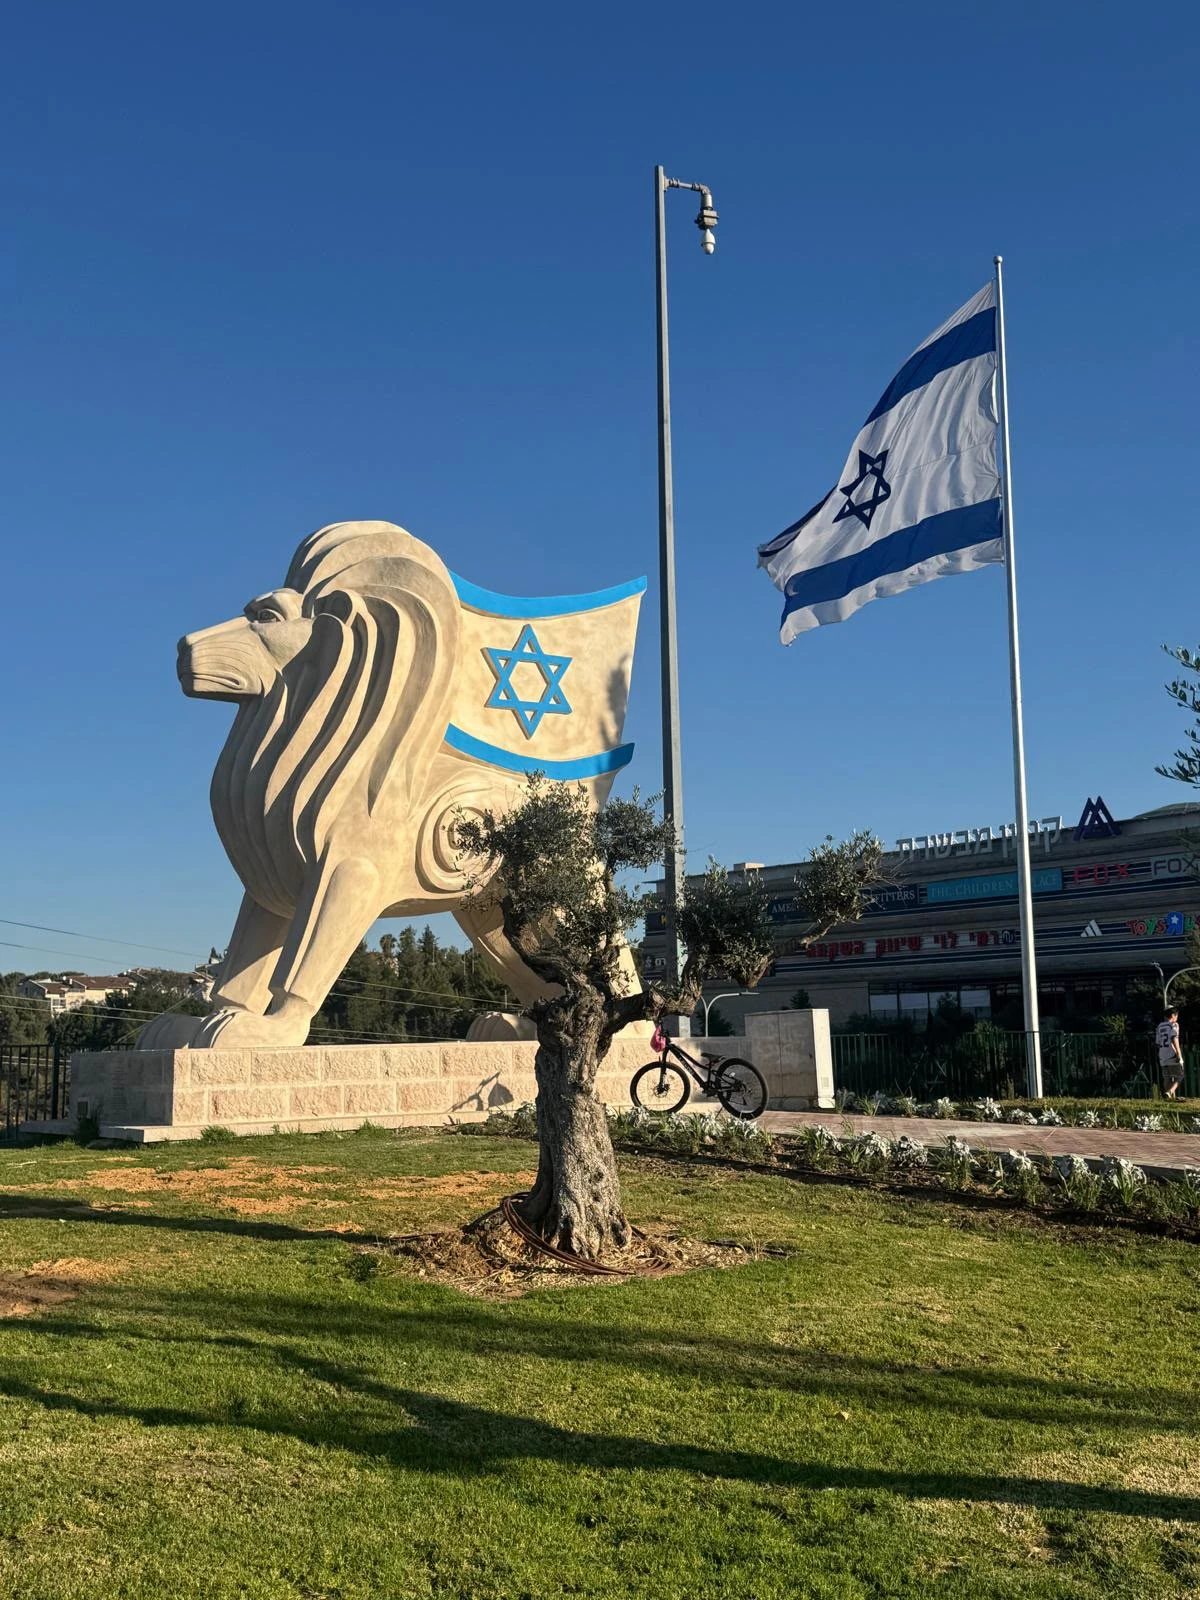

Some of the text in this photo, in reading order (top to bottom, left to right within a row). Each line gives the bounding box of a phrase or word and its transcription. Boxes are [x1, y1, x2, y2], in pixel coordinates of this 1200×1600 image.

[896, 816, 1063, 860] קנון מבשרת
[1072, 863, 1131, 885] FOX
[1154, 857, 1196, 876] FOX
[931, 886, 949, 898] THE
[1033, 873, 1057, 888] LACE
[934, 930, 956, 948] לוי
[969, 930, 999, 947] רמי
